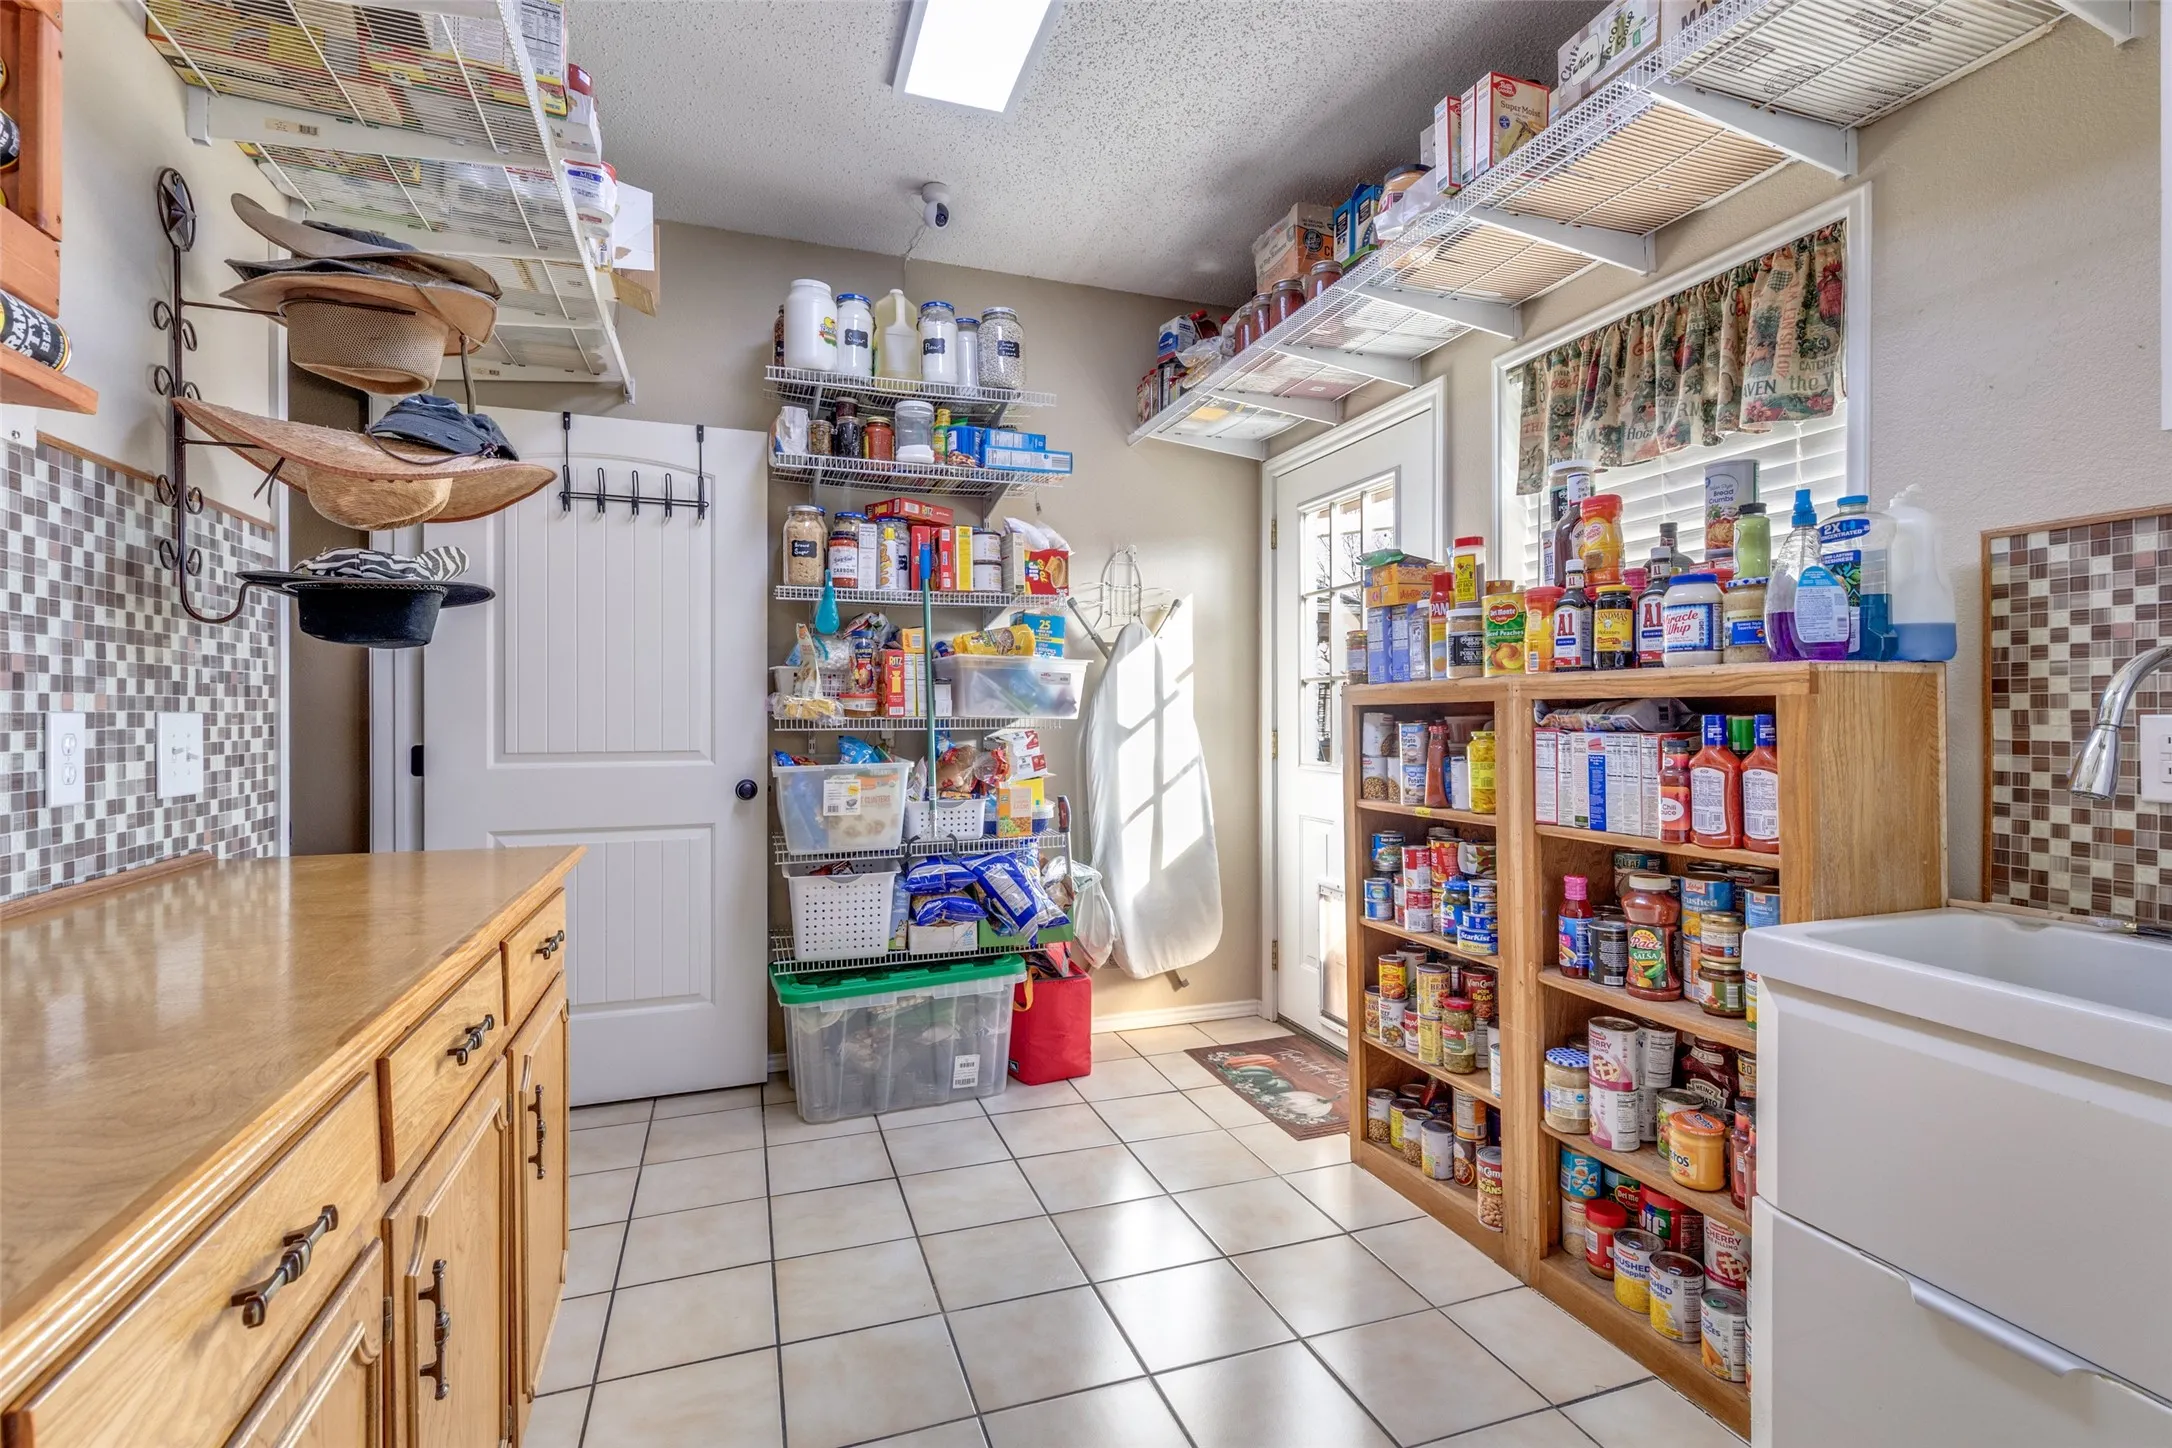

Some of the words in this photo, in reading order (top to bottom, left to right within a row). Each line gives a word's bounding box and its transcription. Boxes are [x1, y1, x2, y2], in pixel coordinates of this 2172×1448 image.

[1713, 489, 1734, 497] Bread
[1708, 496, 1734, 504] Crumbs
[1823, 523, 1841, 535] 2X
[1431, 602, 1449, 616] PAM
[1499, 607, 1516, 615] Monte
[1039, 619, 1051, 630] 25
[1499, 629, 1524, 637] Peaches
[888, 655, 903, 666] RITZ
[1459, 931, 1491, 941] StarKist
[1634, 952, 1658, 960] SALSA
[1695, 1083, 1714, 1095] HEINZ
[1639, 1208, 1667, 1236] Jif
[1705, 1226, 1742, 1247] CHERRY
[1714, 1239, 1739, 1251] FILLING
